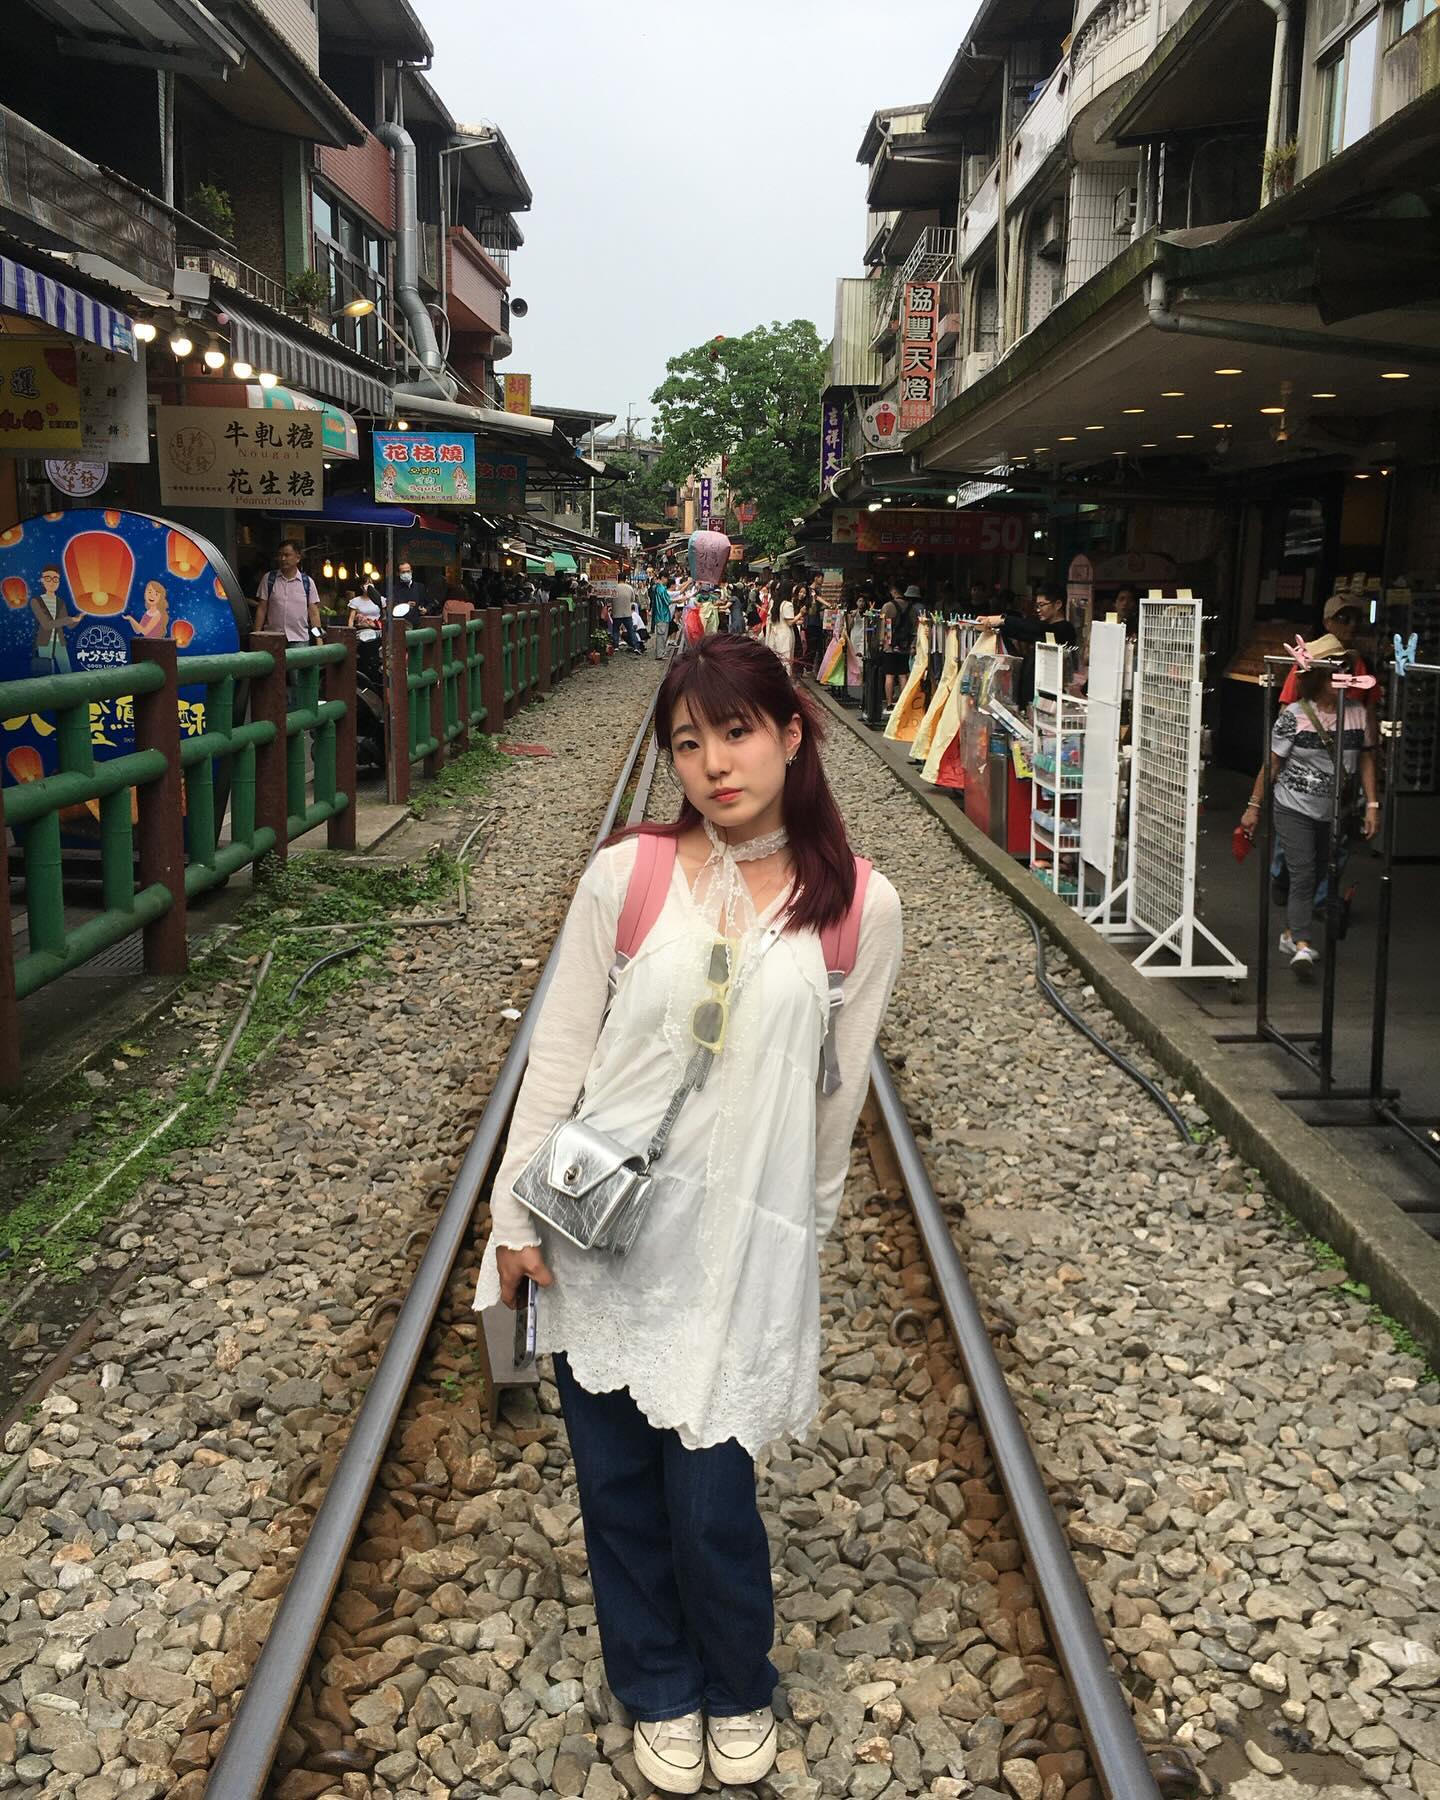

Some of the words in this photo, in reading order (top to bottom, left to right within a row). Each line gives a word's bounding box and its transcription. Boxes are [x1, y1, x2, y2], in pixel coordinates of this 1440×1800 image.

[903, 286, 934, 402] 協豐天燈
[224, 421, 314, 448] 牛軋糖
[384, 443, 464, 463] 花枝燒
[228, 469, 315, 496] 花生糖
[408, 484, 442, 492] Squid
[236, 497, 272, 505] Peanut
[274, 498, 307, 507] Candy
[979, 515, 1023, 551] 50
[77, 649, 127, 663] 十分好運
